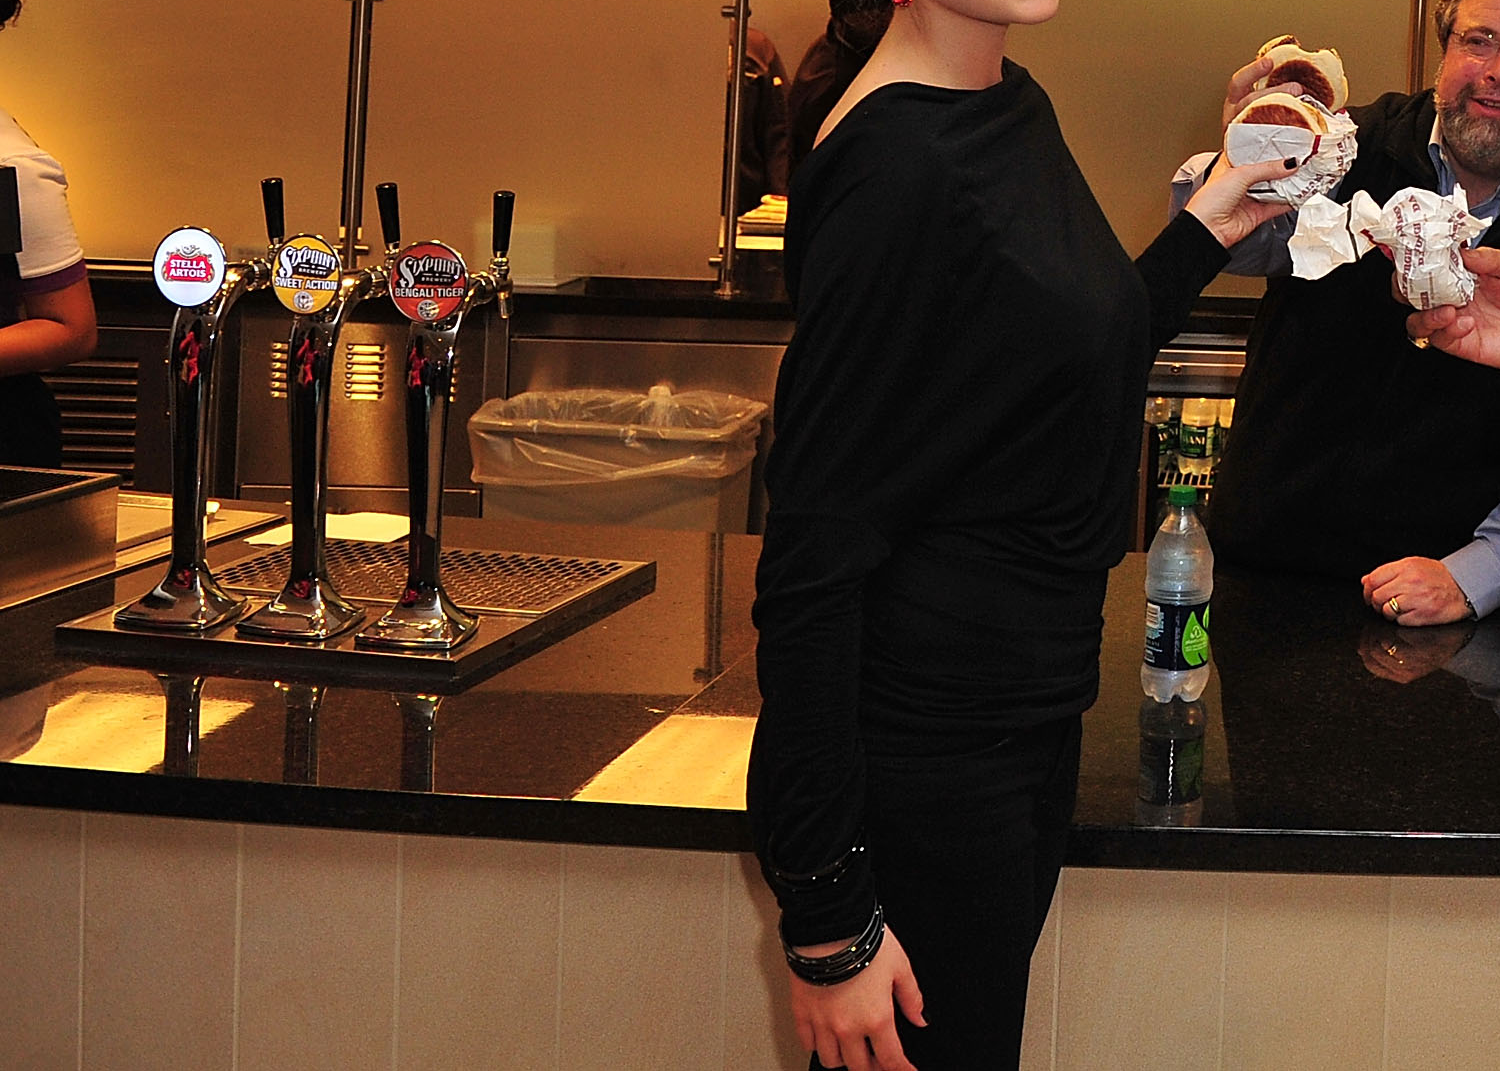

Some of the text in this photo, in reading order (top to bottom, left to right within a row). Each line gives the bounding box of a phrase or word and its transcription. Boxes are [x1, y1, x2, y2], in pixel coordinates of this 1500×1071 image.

[170, 259, 206, 269] STELLA
[169, 269, 207, 278] ARTOIS
[298, 268, 327, 276] BREWERY
[275, 277, 338, 290] SWEET ACTION
[395, 288, 465, 298] BENGALI TIGER
